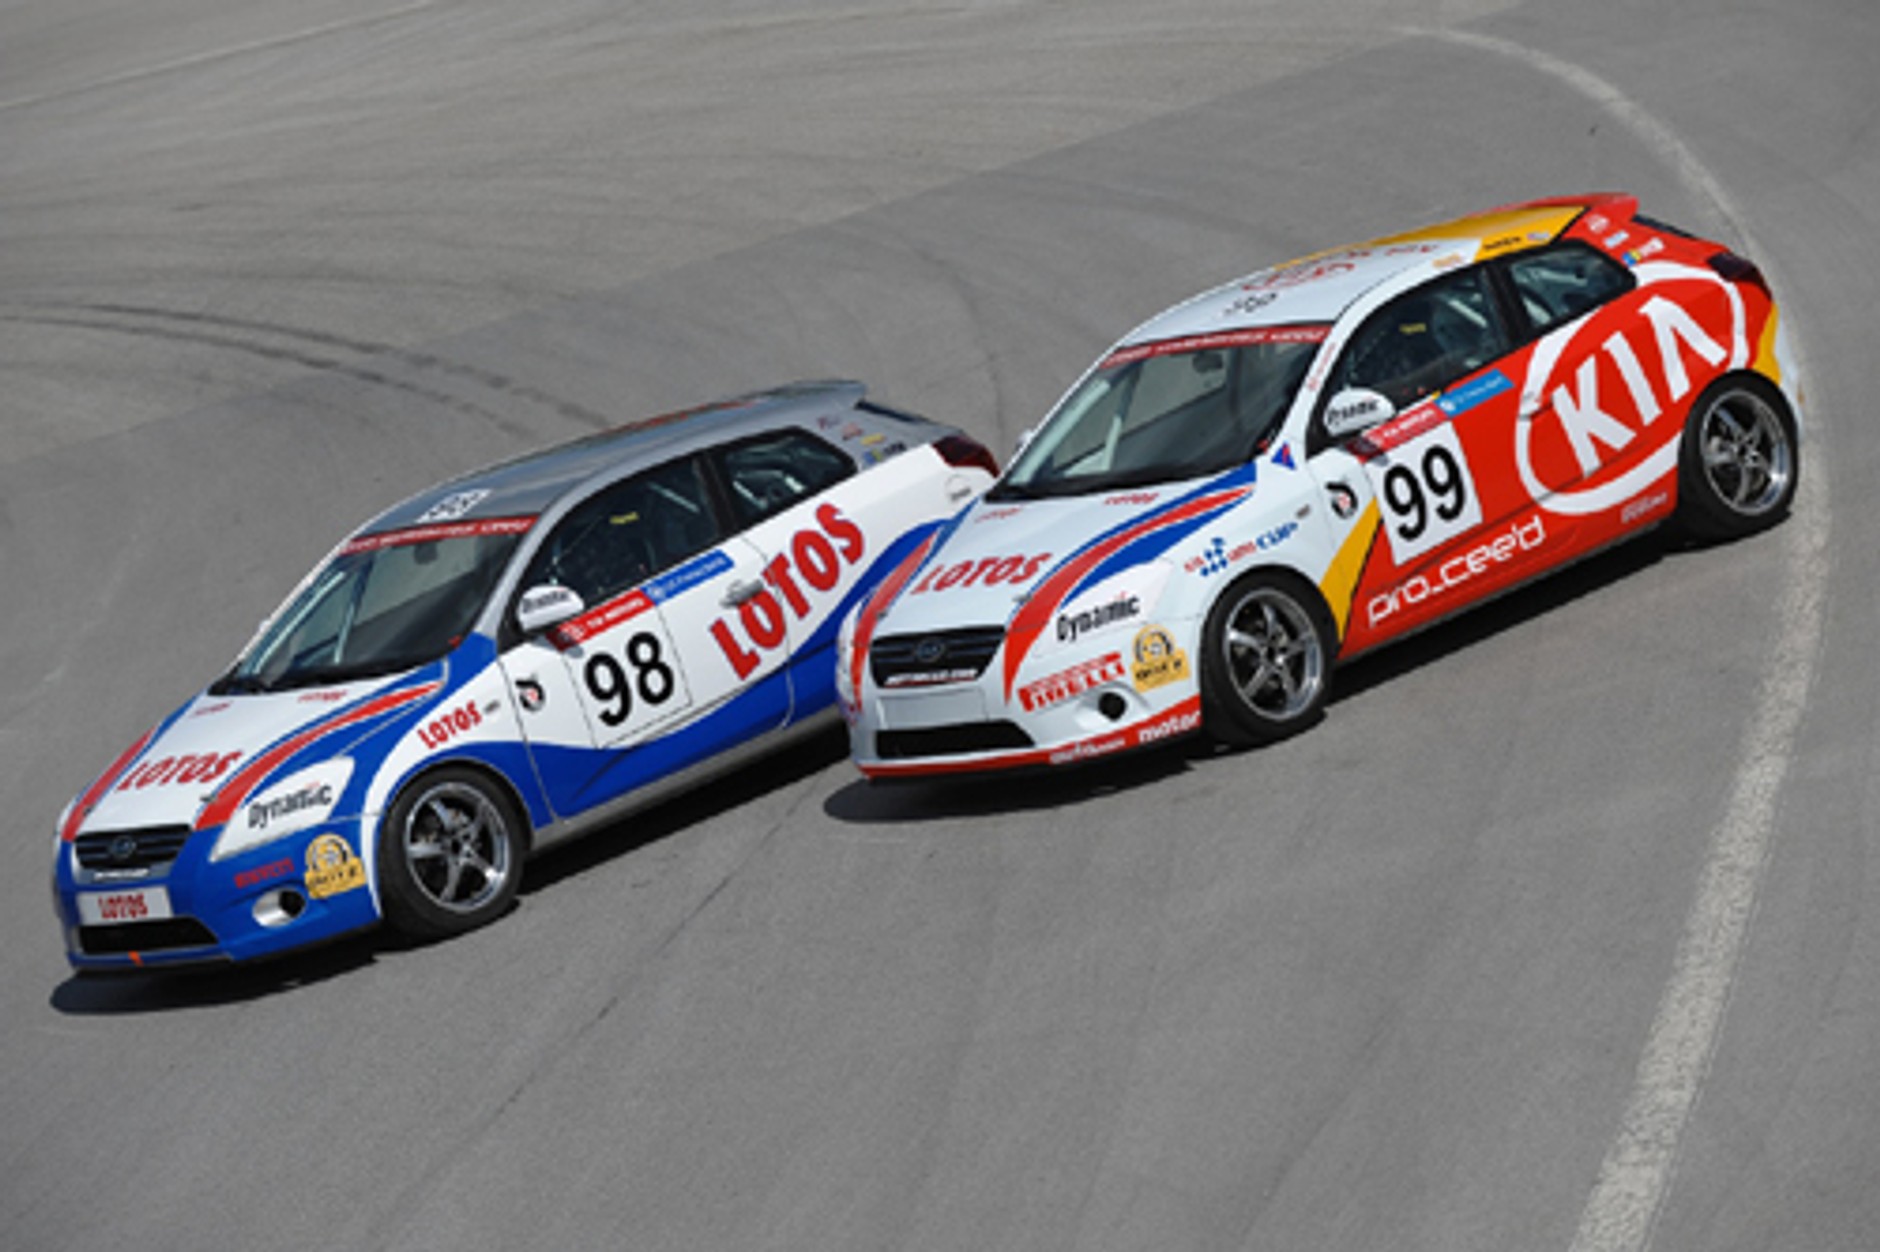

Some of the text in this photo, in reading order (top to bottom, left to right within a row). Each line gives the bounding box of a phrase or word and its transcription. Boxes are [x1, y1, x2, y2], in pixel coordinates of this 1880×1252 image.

[1552, 296, 1727, 478] KIA
[1384, 444, 1466, 542] 99
[710, 503, 864, 681] LOTOS
[911, 552, 1053, 596] LOTOS
[1057, 594, 1140, 642] Dynamic
[584, 631, 675, 727] 98
[417, 701, 483, 749] LOTOS
[116, 751, 243, 792] LOTOS
